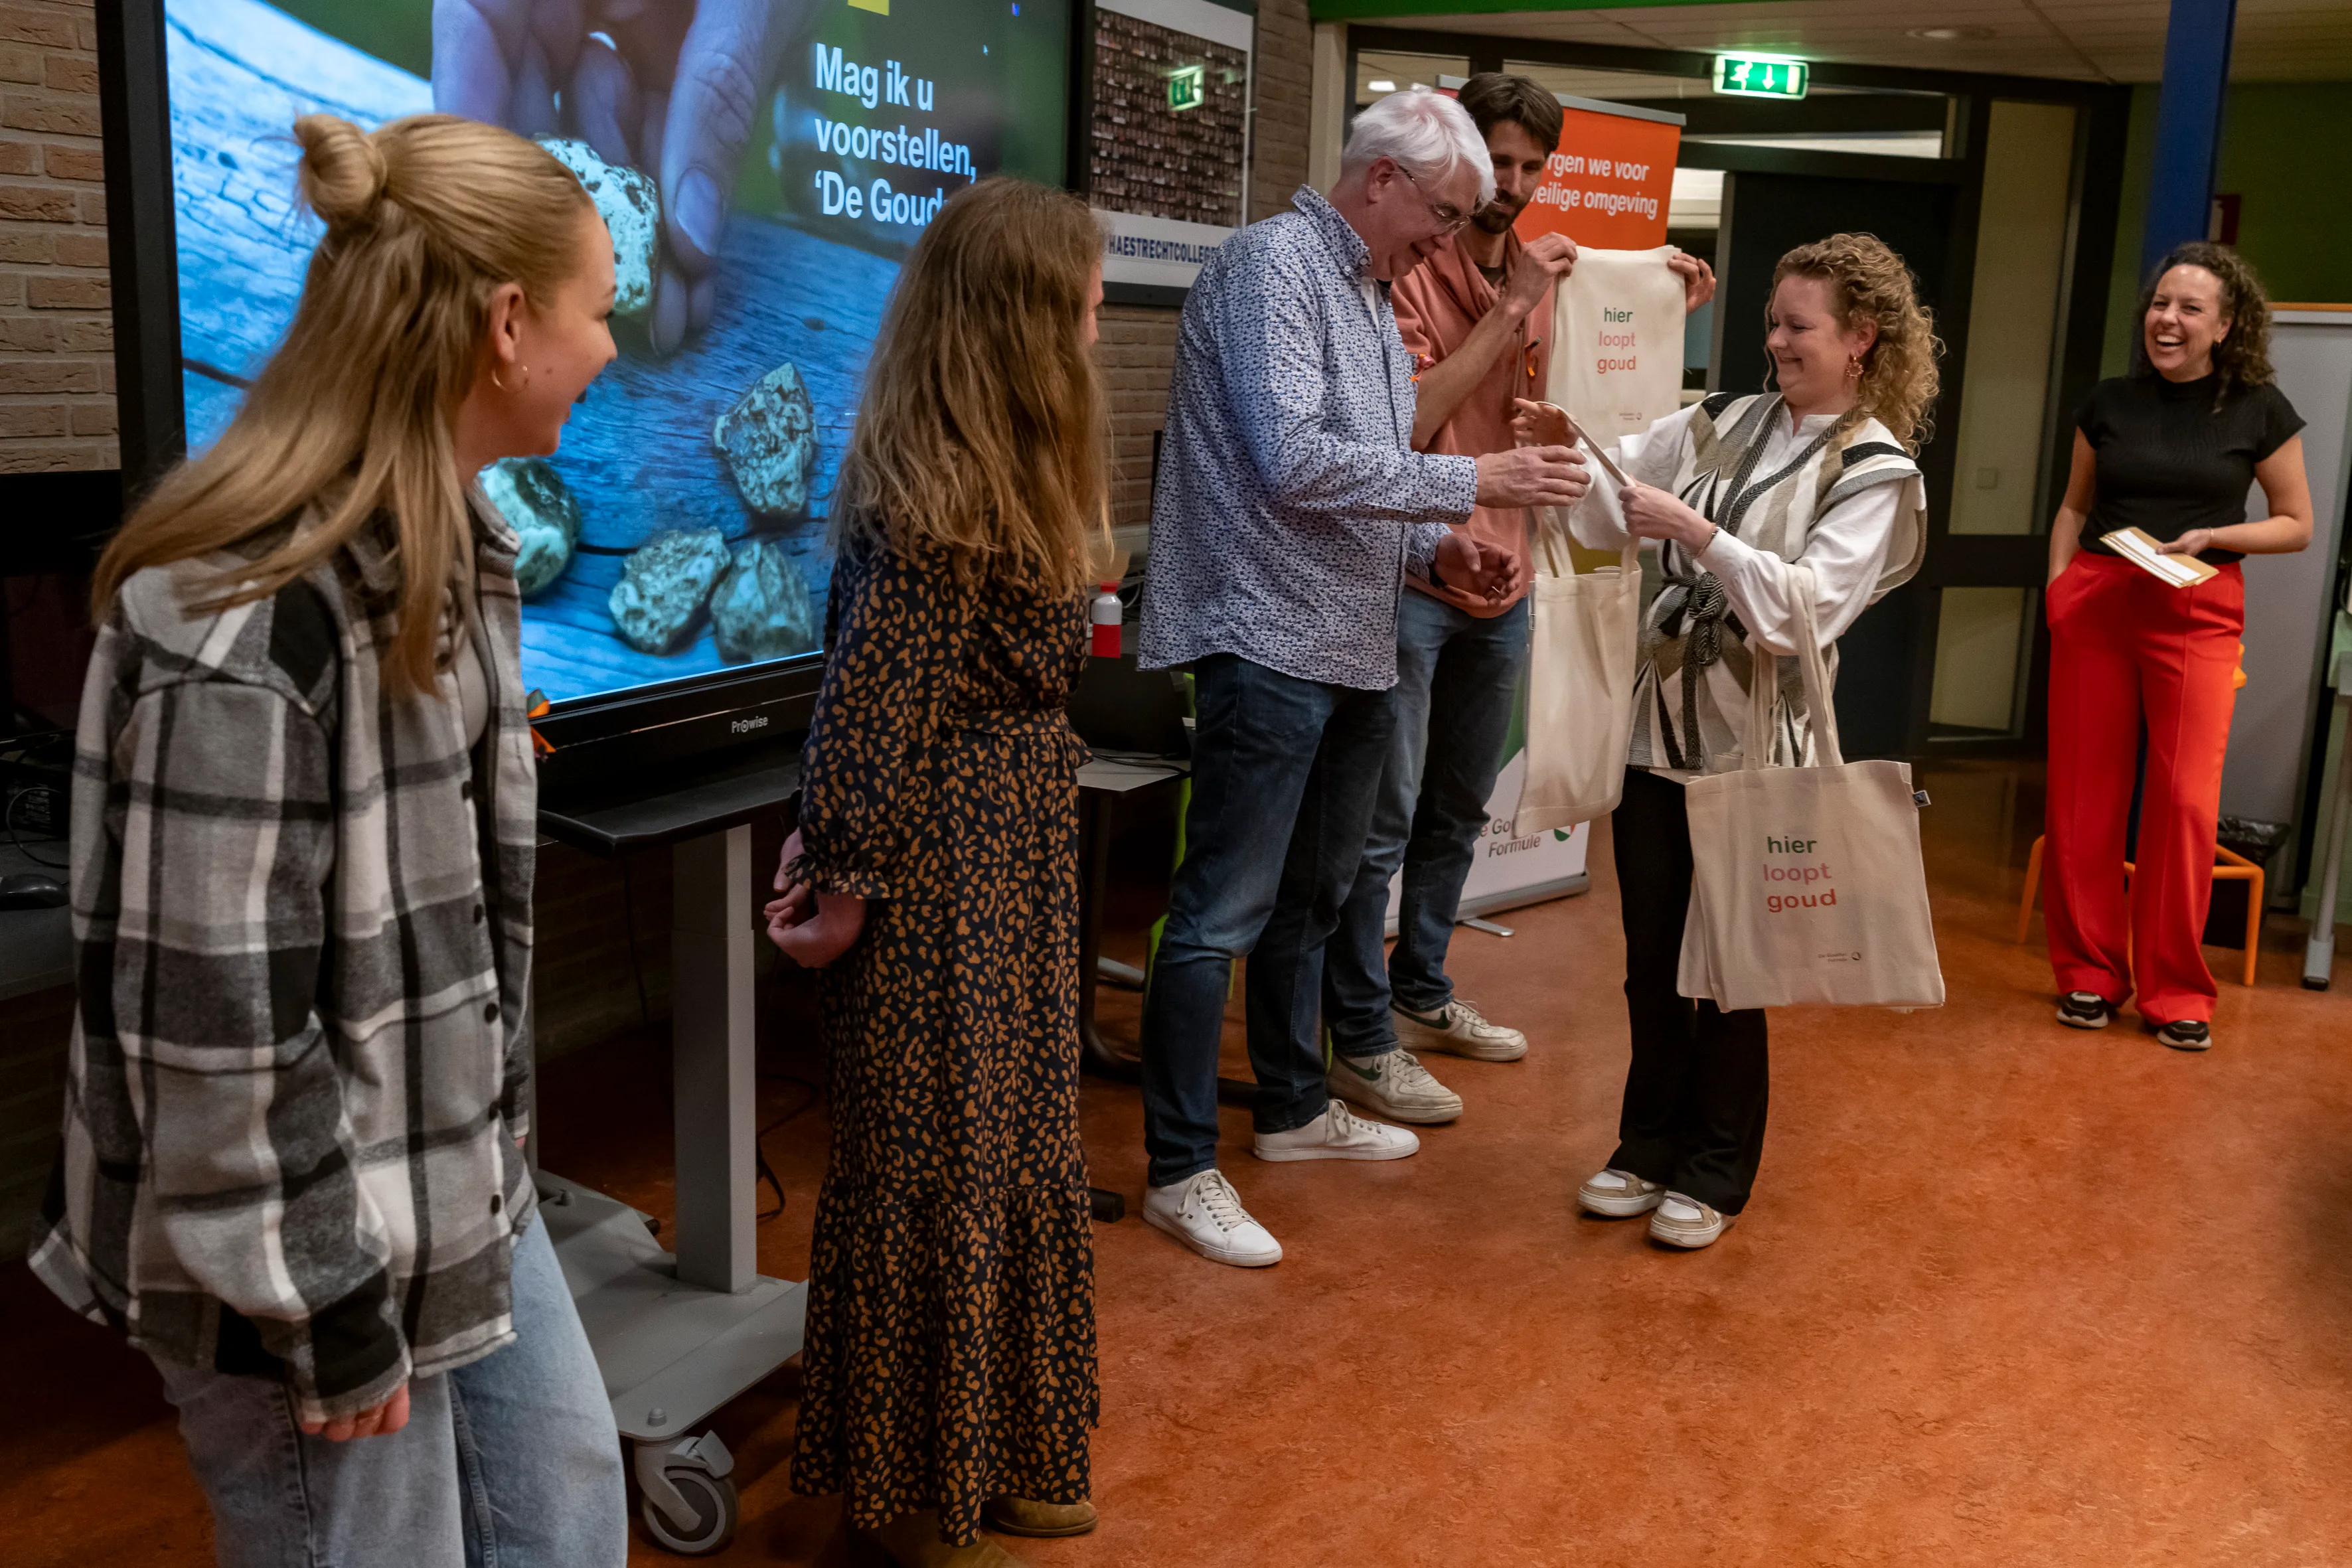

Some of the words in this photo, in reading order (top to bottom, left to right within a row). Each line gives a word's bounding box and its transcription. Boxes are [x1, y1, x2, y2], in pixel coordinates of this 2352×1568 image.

[816, 42, 878, 109] Mag
[886, 60, 910, 106] ik
[917, 78, 933, 111] u
[815, 118, 977, 184] voorstellen,
[1547, 153, 1585, 177] rgen
[1589, 157, 1611, 177] we
[1614, 161, 1650, 181] voor
[870, 178, 944, 226] Goud
[1584, 191, 1658, 220] omgeving
[1604, 307, 1633, 323] hier
[1599, 331, 1636, 350] loopt
[1597, 355, 1636, 374] goud
[1488, 834, 1541, 858] Formule
[1767, 836, 1817, 854] hier
[1763, 862, 1832, 885] loopt
[1767, 888, 1837, 913] goud
